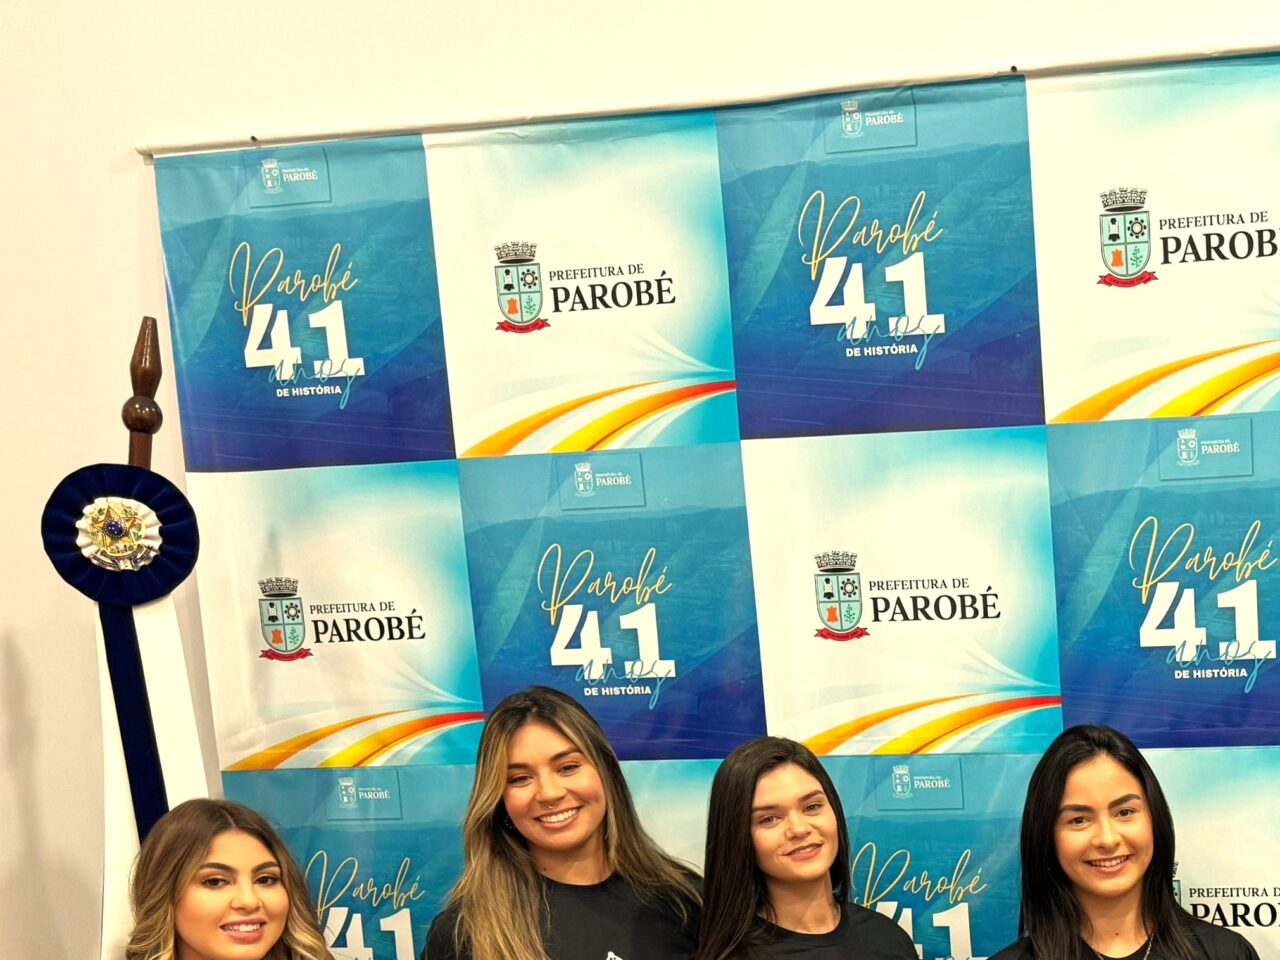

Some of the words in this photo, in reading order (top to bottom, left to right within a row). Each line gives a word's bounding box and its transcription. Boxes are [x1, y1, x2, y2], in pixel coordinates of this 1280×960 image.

[798, 190, 943, 281] Parobé
[1159, 213, 1245, 230] PREFEITURA
[1250, 211, 1268, 223] DE
[229, 242, 358, 326] Parobé
[549, 266, 624, 281] PREFEITURA
[628, 263, 644, 274] DE
[550, 270, 676, 313] PAROBÉ
[809, 252, 946, 339] 41
[244, 300, 365, 380] 41
[846, 347, 861, 358] DE
[864, 343, 918, 357] HISTÓRIA
[276, 387, 289, 397] DE
[292, 384, 342, 396] HISTÓRIA
[1201, 441, 1240, 455] PAROBÉ
[1129, 516, 1279, 605] Parobé
[537, 543, 673, 625] Parobé
[869, 579, 947, 591] PREFEITURA
[952, 578, 969, 588] DE
[310, 602, 376, 614] PREFEITURA
[379, 601, 396, 612] DE
[870, 585, 1001, 622] PAROBÉ
[1139, 579, 1277, 662] 41
[311, 608, 426, 644] PAROBÉ
[550, 602, 676, 680] 41
[584, 686, 599, 696] DE
[601, 683, 652, 695] HISTÓRIA
[1174, 670, 1190, 679] DE
[1193, 666, 1248, 678] HISTÓRIA
[305, 850, 425, 925] Parobé
[1189, 887, 1269, 898] PREFEITURA
